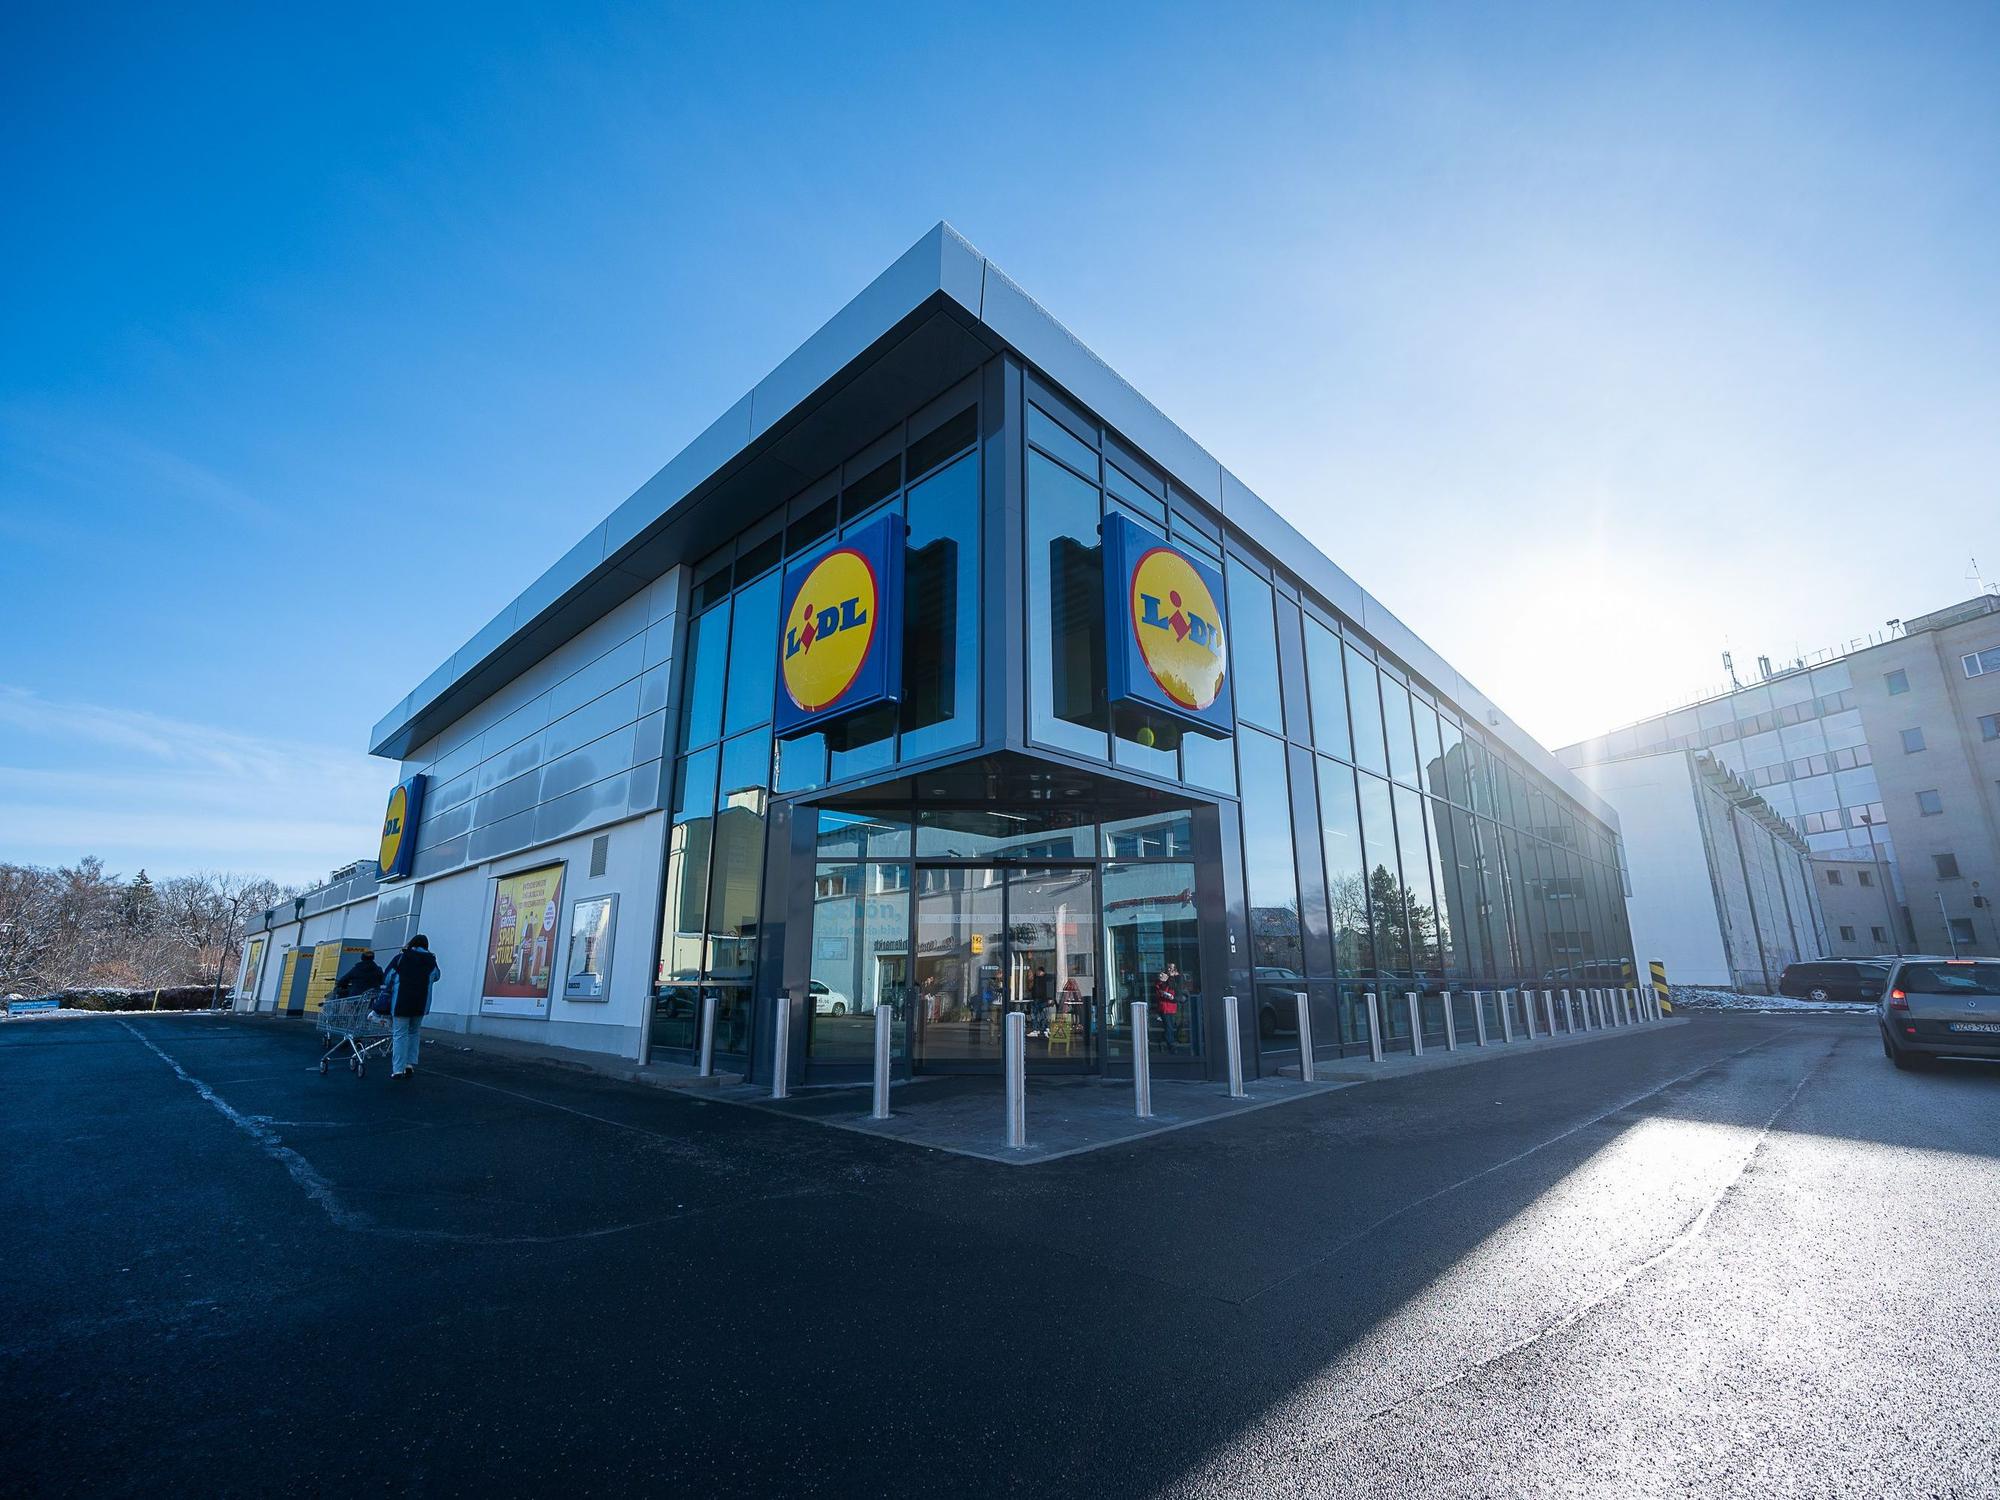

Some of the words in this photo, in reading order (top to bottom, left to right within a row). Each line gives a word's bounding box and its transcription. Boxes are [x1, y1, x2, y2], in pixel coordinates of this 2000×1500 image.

[385, 817, 401, 836] DL
[498, 927, 515, 946] SPAR
[495, 945, 514, 964] STURZ
